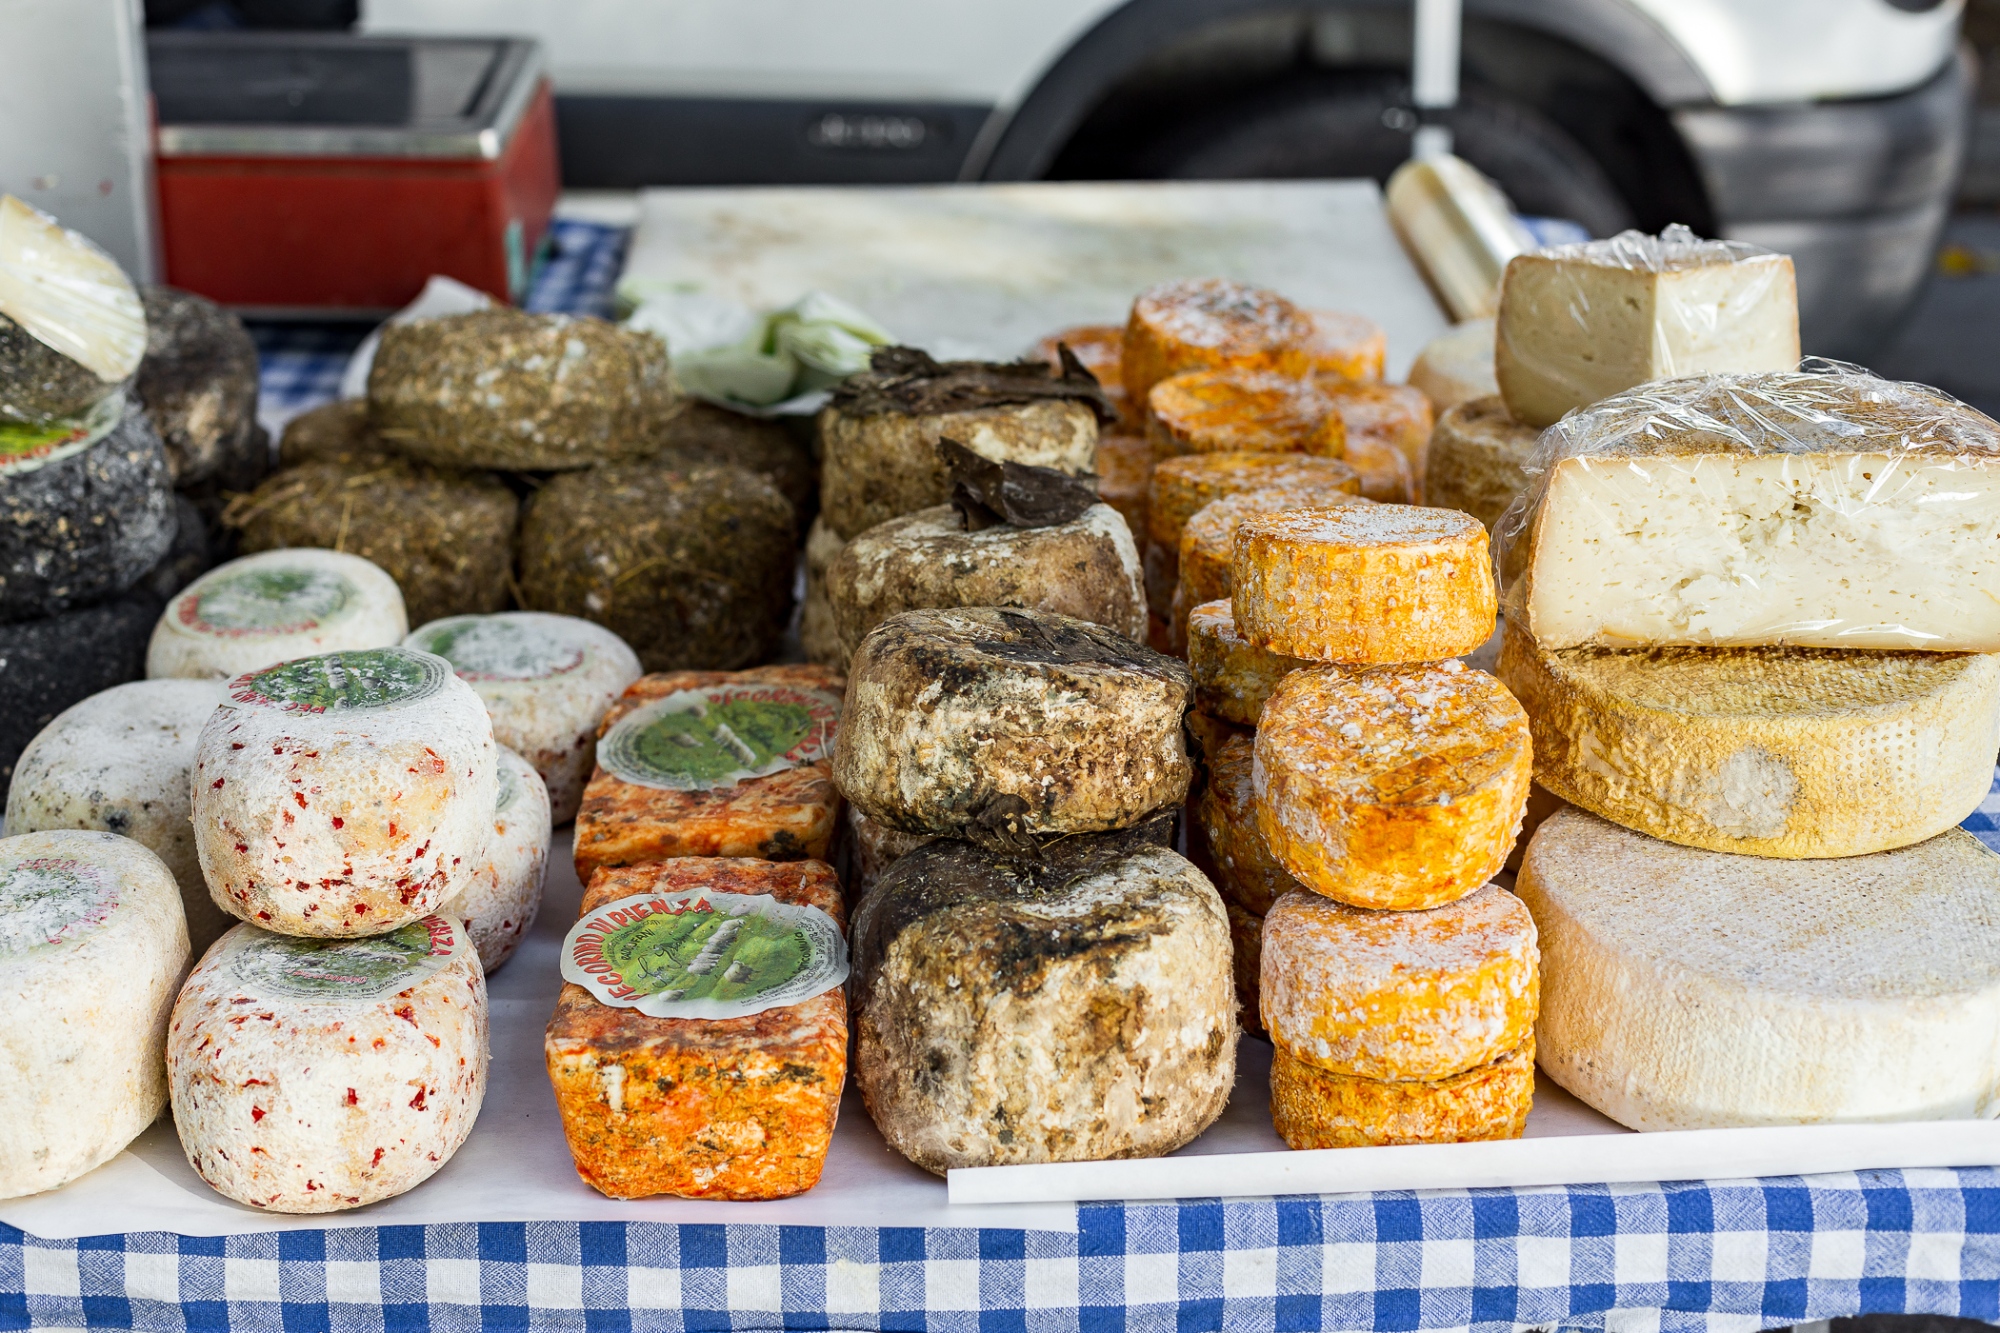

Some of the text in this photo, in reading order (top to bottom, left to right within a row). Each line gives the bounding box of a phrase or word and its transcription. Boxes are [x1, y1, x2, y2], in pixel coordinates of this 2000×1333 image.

[585, 917, 621, 934] DI
[606, 896, 714, 927] PIENZA
[573, 933, 650, 1001] PECORINO
